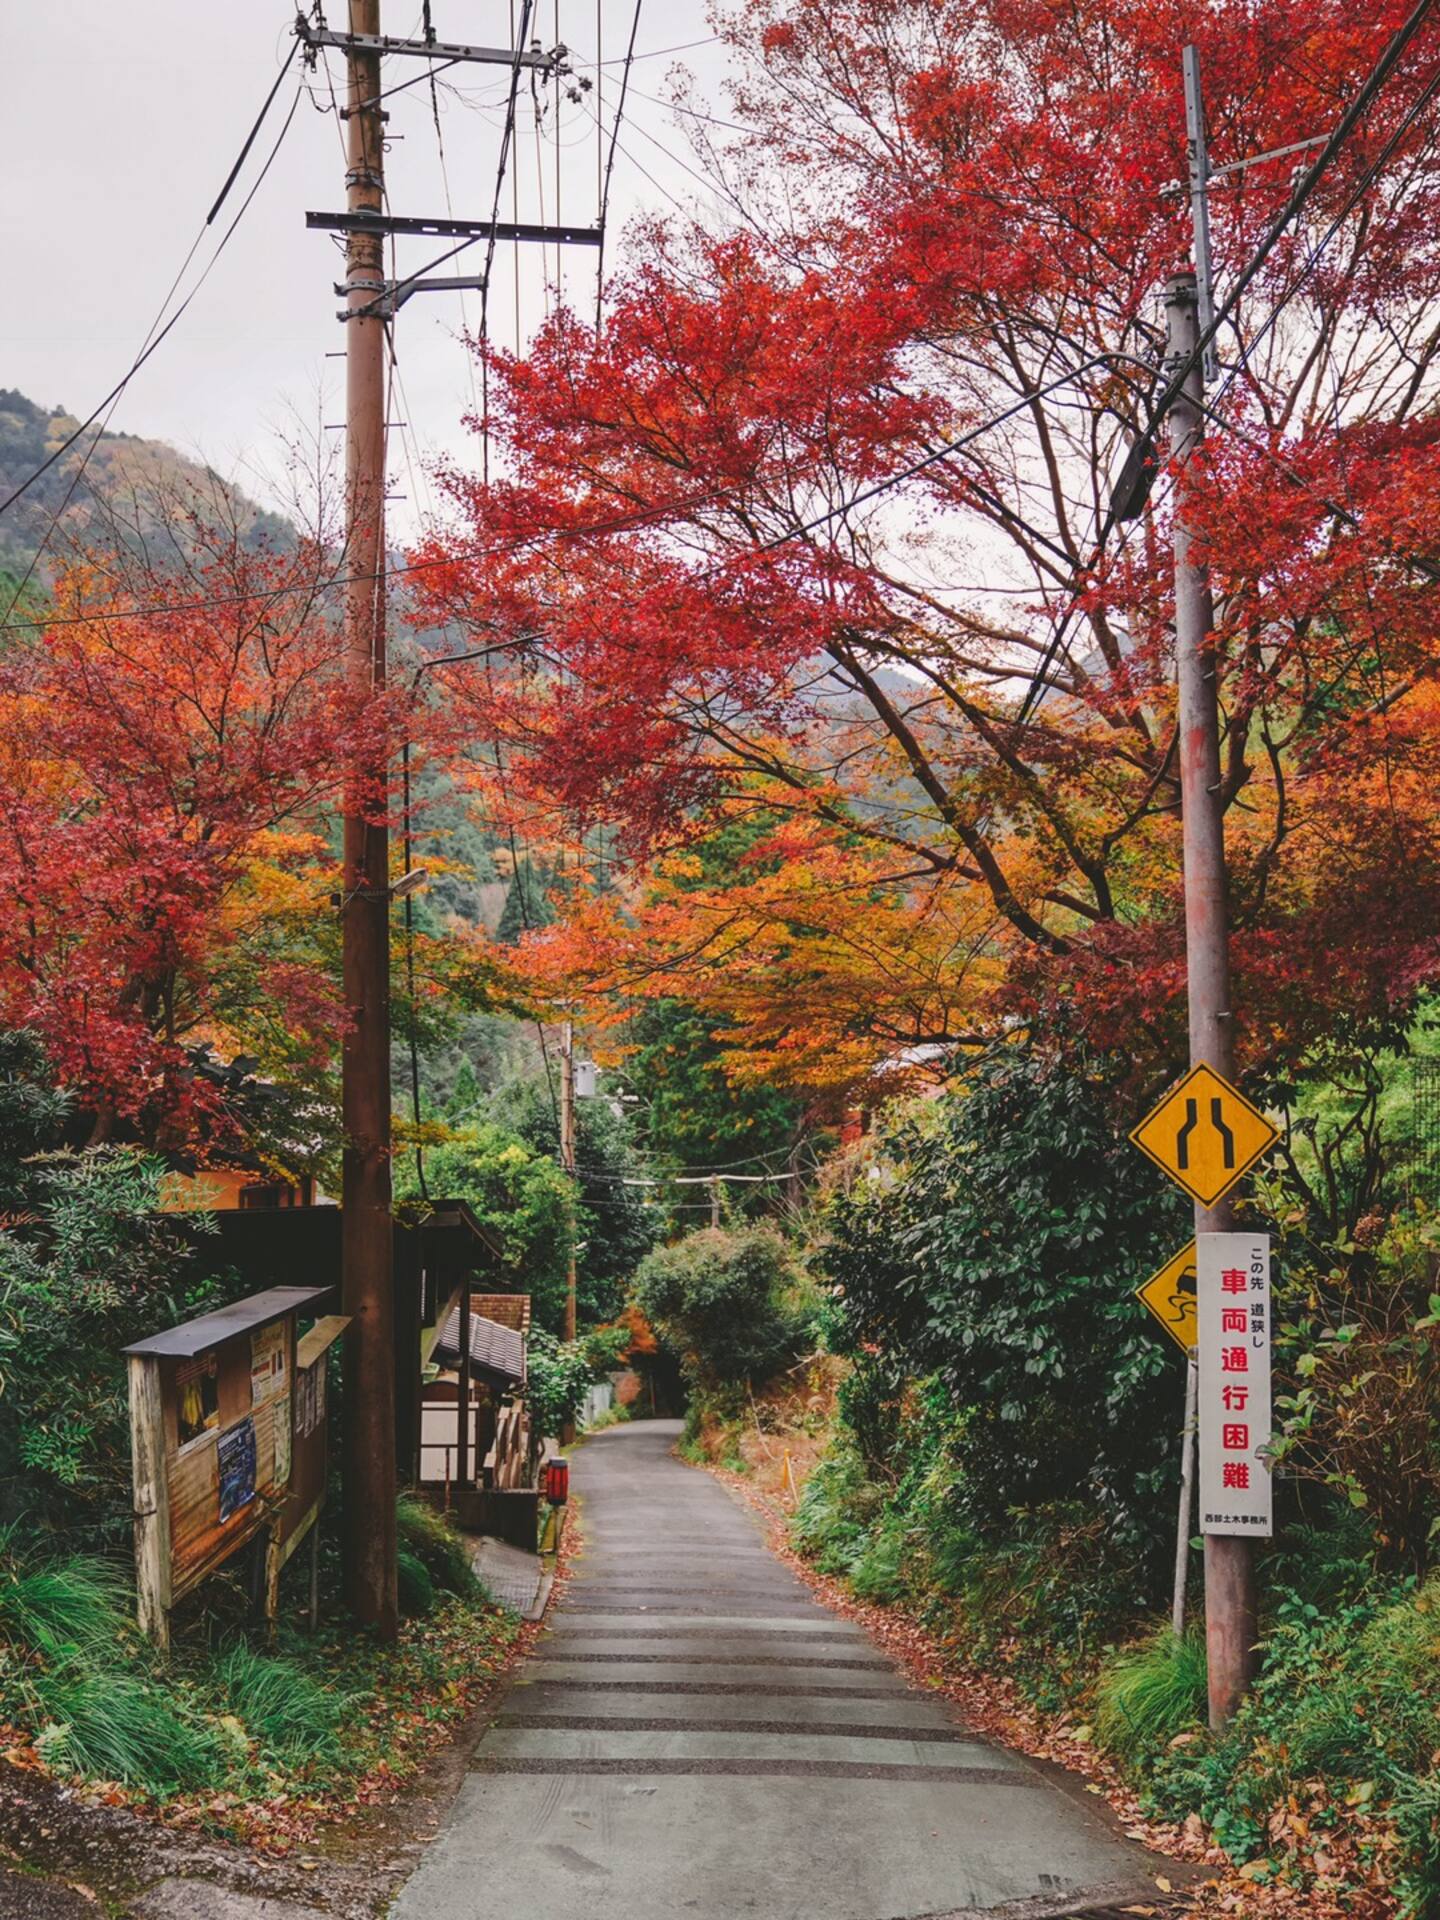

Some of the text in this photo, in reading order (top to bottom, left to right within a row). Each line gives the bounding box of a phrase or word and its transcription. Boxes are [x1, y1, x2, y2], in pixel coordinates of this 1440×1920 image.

[1250, 1247, 1265, 1348] この先 道狭し
[1220, 1268, 1249, 1489] 車両通行困難
[1205, 1513, 1268, 1525] 西部土木事務所
